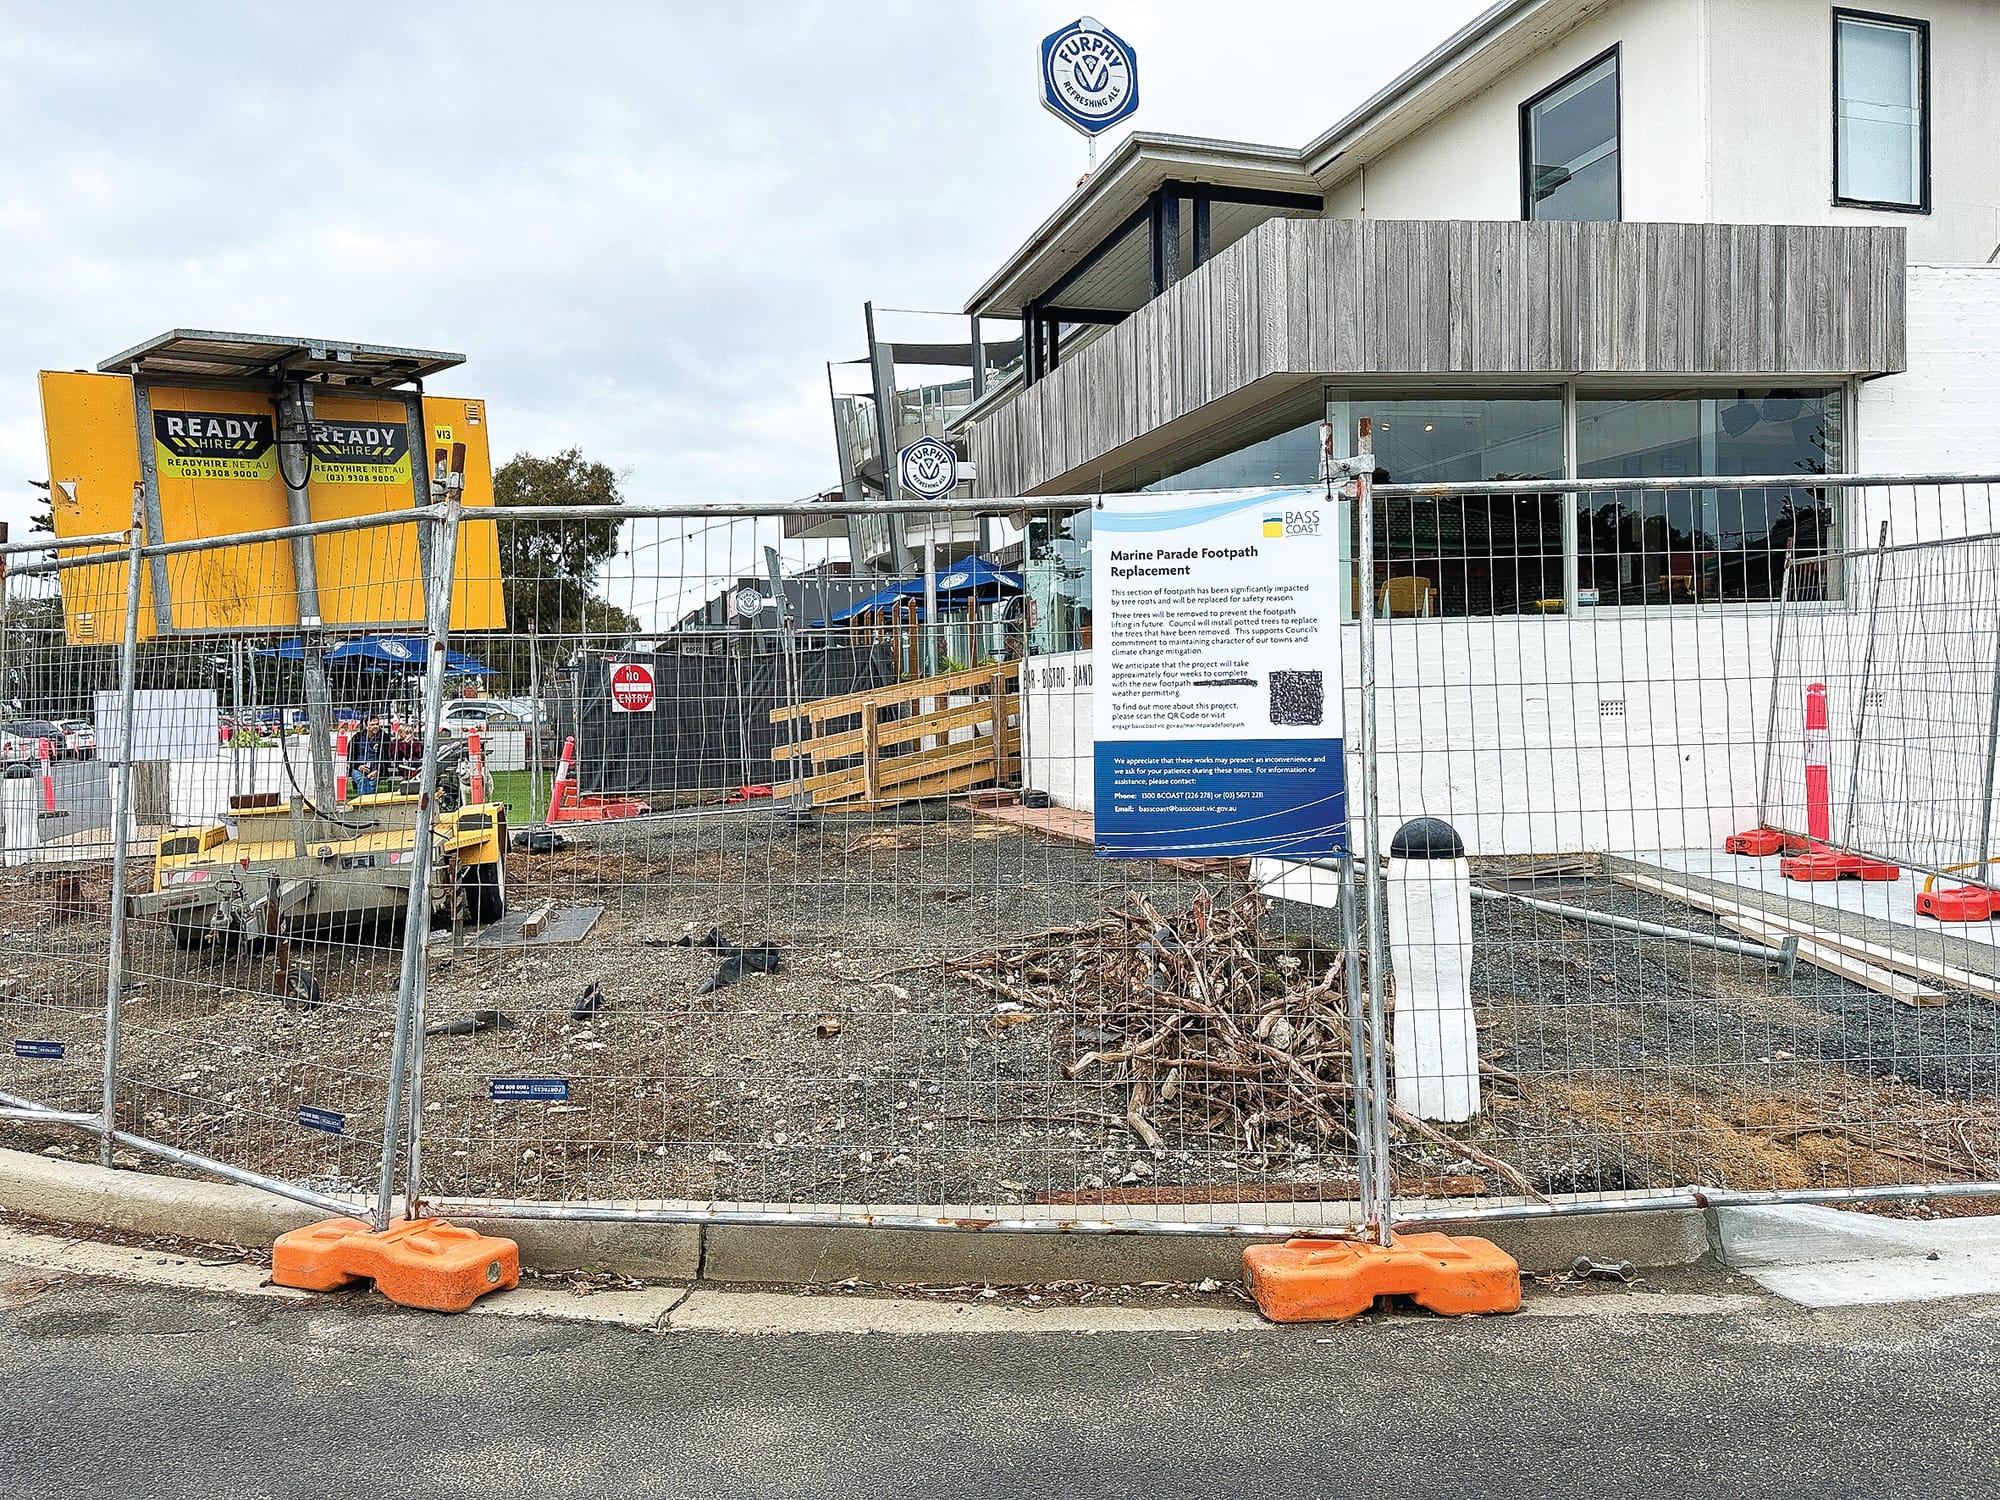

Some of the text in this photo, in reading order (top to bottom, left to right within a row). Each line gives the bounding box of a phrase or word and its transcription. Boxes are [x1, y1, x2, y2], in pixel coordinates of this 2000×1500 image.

[1059, 36, 1123, 68] FURPHY
[1063, 81, 1121, 108] REFRESHING ALE
[167, 417, 258, 439] READY
[315, 427, 395, 446] READY
[200, 438, 232, 450] HIRE
[342, 446, 371, 456] HIRE
[910, 447, 948, 465] FURPHY
[167, 458, 269, 469] READYHIRE.NET.AU
[314, 464, 404, 474] READYHIRE.NET.AU
[181, 468, 258, 478] (03) 9308 9000
[326, 474, 395, 482] (03) 9308 9000
[1285, 510, 1320, 525] BASS
[1286, 523, 1319, 534] COAST
[1110, 546, 1259, 561] Marine Parade Footpath
[1110, 564, 1191, 579] Replacement
[1127, 588, 1152, 596] section
[1154, 587, 1162, 595] of
[1164, 587, 1195, 596] footpath
[1197, 587, 1209, 595] has
[1211, 586, 1229, 594] been
[1230, 585, 1273, 595] significantly
[1275, 584, 1309, 594] impacted
[1111, 598, 1120, 607] by
[1158, 597, 1171, 605] and
[1187, 596, 1196, 604] be
[1198, 596, 1228, 605] replaced
[1230, 595, 1240, 603] for
[1242, 595, 1264, 603] safety
[1177, 610, 1208, 618] removed
[1220, 610, 1247, 618] prevent
[1249, 608, 1262, 616] the
[1263, 608, 1296, 617] footpath
[1111, 621, 1132, 630] lifting
[1168, 619, 1196, 627] Council
[1211, 618, 1233, 626] install
[1234, 618, 1260, 627] potted
[1291, 617, 1318, 626] replace
[1144, 629, 1159, 637] that
[1160, 629, 1177, 637] have
[1178, 628, 1197, 636] been
[1235, 627, 1250, 635] This
[1251, 627, 1284, 636] supports
[1285, 625, 1318, 634] Council's
[1169, 638, 1210, 647] maintaining
[1211, 637, 1245, 645] character
[1246, 636, 1255, 644] of
[1294, 635, 1309, 643] and
[1111, 648, 1138, 656] climate
[1138, 648, 1164, 657] change
[1112, 662, 1124, 670] We
[1125, 662, 1160, 670] anticipate
[1161, 661, 1177, 669] that
[1191, 661, 1218, 670] project
[1219, 660, 1232, 668] will
[1233, 660, 1250, 668] take
[626, 672, 639, 681] NO
[1024, 670, 1035, 689] BAR
[1042, 667, 1065, 688] BISTRO
[1112, 671, 1161, 680] approximately
[1179, 670, 1202, 678] weeks
[1213, 669, 1248, 678] complete
[1112, 680, 1128, 688] with
[1129, 680, 1142, 688] the
[1159, 680, 1192, 688] footpath
[619, 693, 649, 704] ENTRY
[1112, 703, 1121, 711] To
[1122, 703, 1137, 711] find
[1172, 702, 1194, 710] about
[1195, 702, 1209, 710] this
[1112, 713, 1135, 721] please
[1167, 712, 1179, 720] QR
[1180, 711, 1200, 719] Code
[1126, 757, 1160, 766] appreciate
[1175, 756, 1193, 764] these
[1193, 756, 1214, 764] works
[1214, 757, 1228, 765] may
[1229, 757, 1254, 765] present
[1312, 755, 1326, 763] and
[1136, 767, 1146, 775] for
[1147, 768, 1163, 776] your
[1163, 767, 1191, 776] patience
[1191, 767, 1214, 776] during
[1256, 766, 1267, 774] For
[1114, 778, 1148, 786] assistance,
[1148, 778, 1169, 786] please
[1114, 791, 1138, 800] Phone:
[1185, 791, 1199, 800] (226
[1199, 791, 1214, 800] 278)
[1235, 791, 1250, 799] 5671
[1114, 805, 1135, 813] Email:
